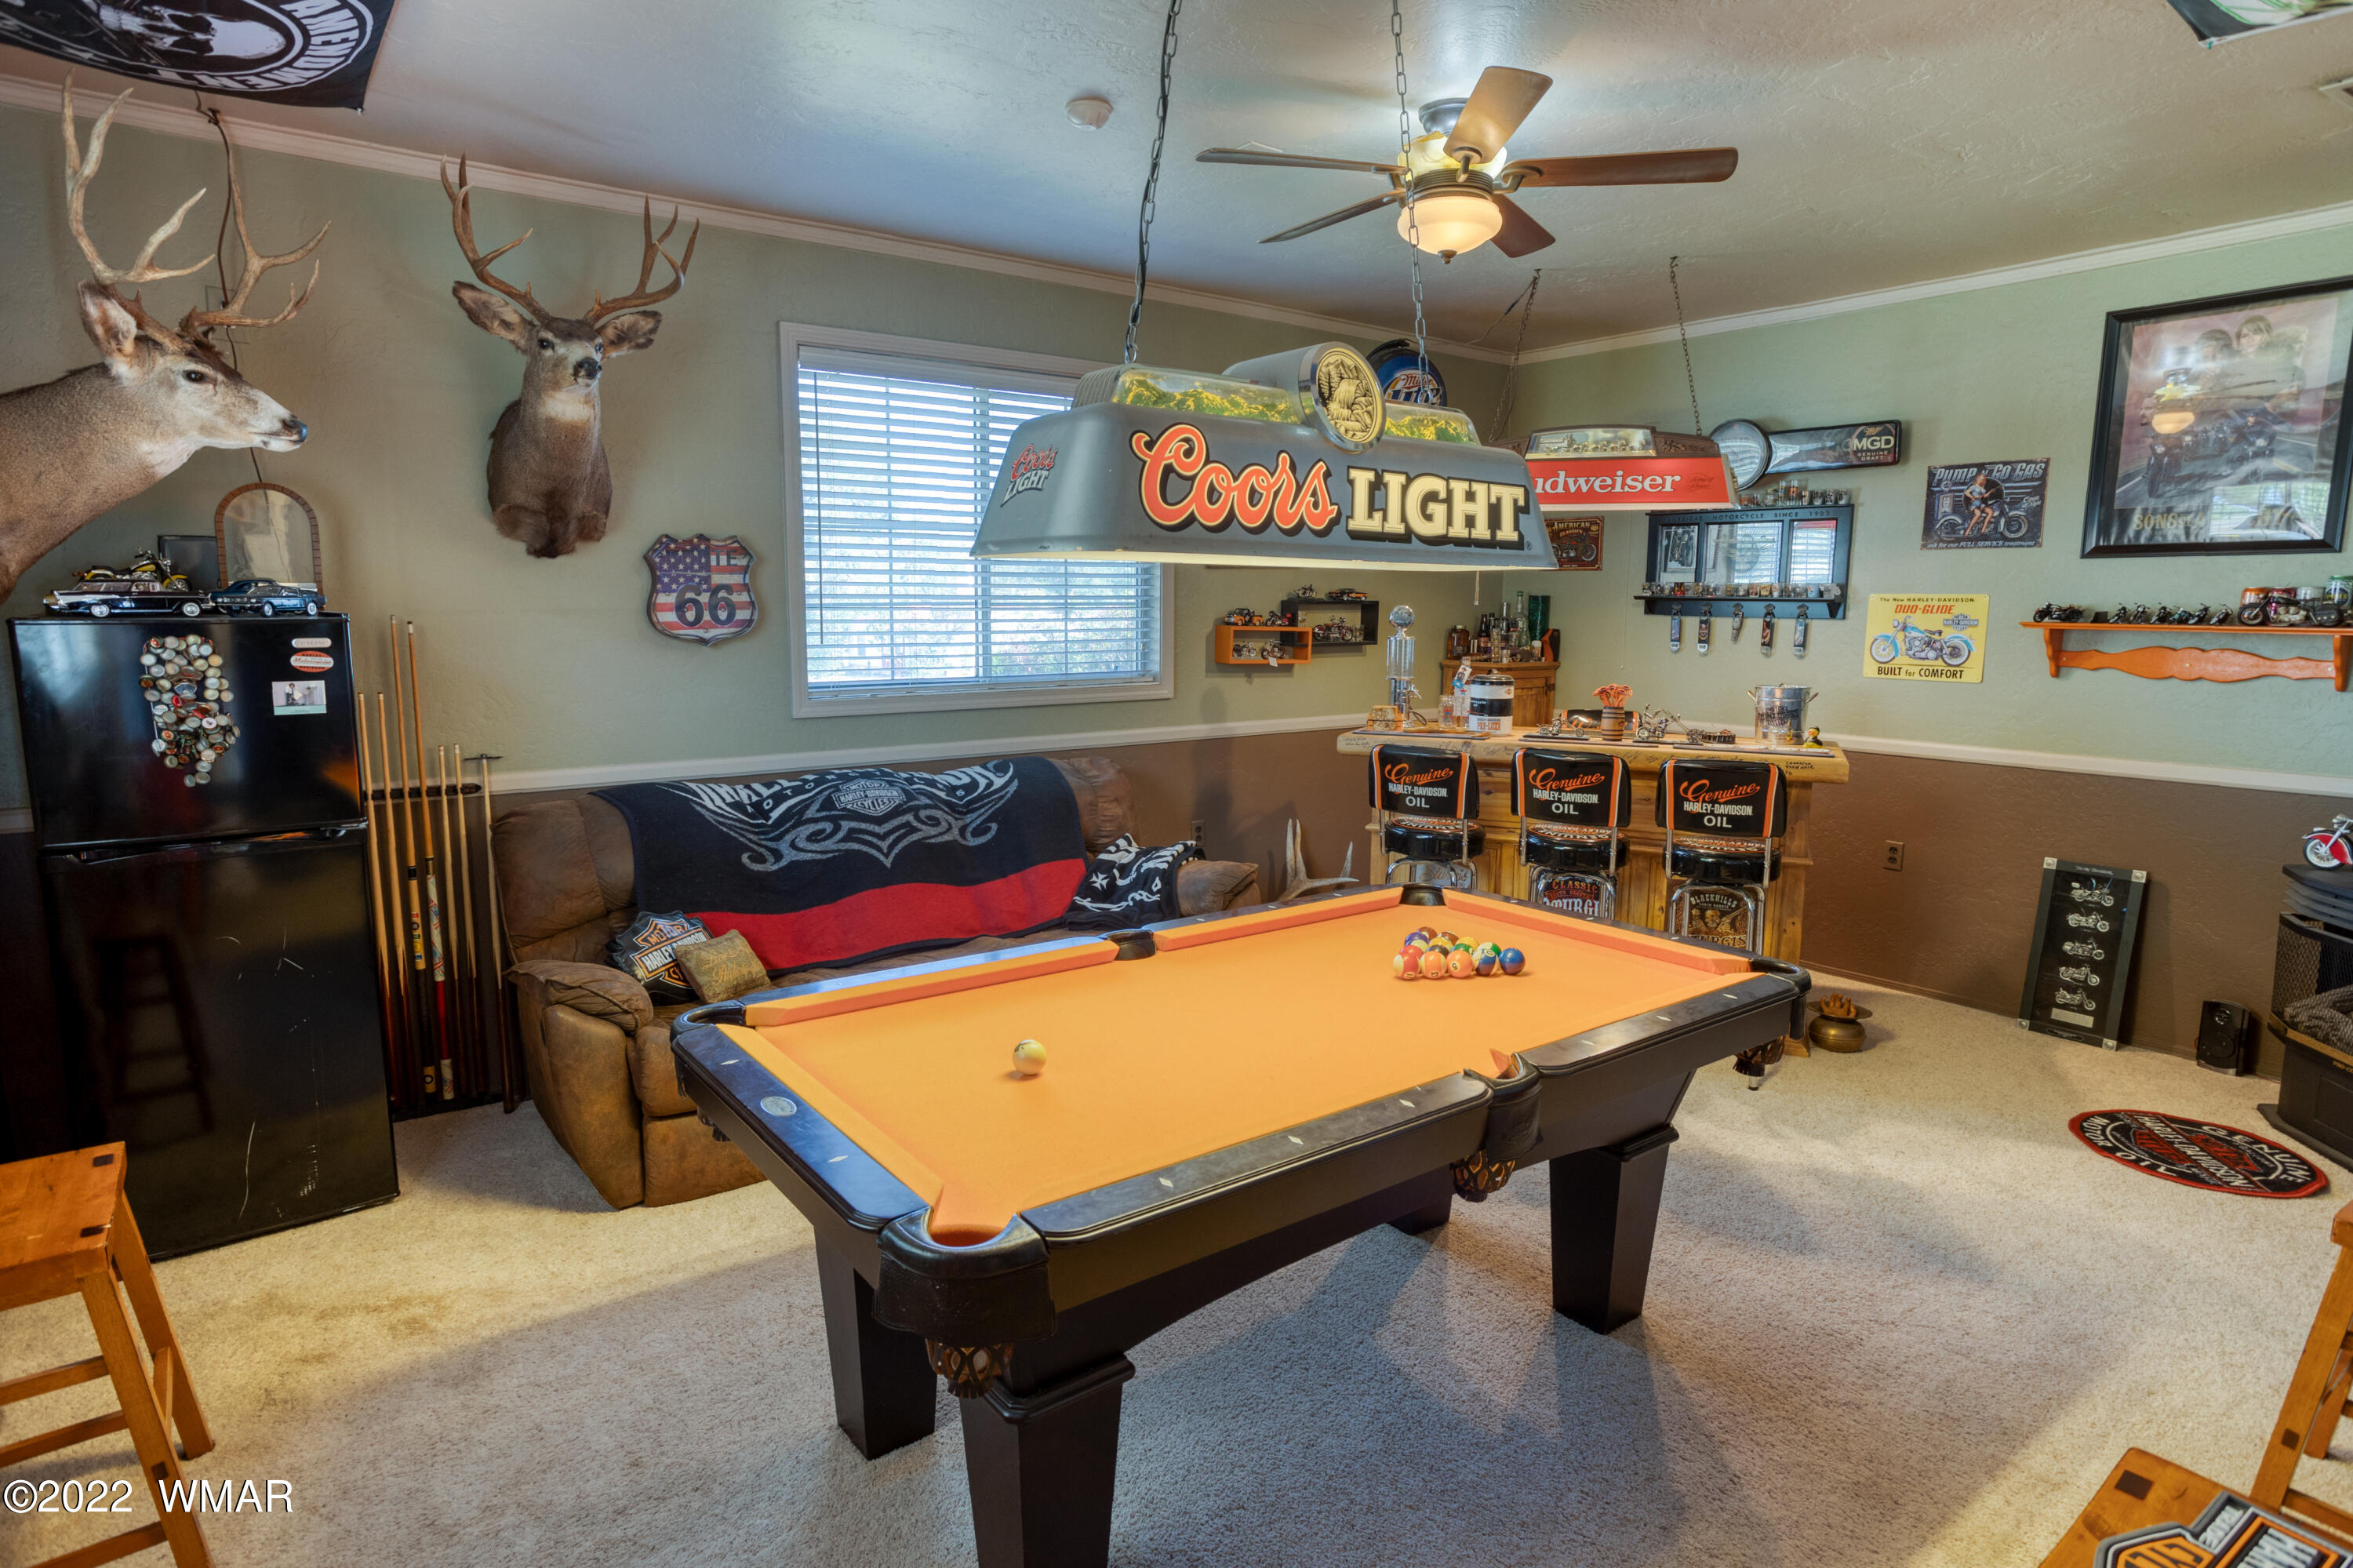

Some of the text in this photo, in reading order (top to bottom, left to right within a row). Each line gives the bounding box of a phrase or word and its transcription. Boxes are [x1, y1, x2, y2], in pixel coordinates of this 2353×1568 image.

[1853, 435, 1894, 451] MGD
[1011, 444, 1058, 481] Coors
[1535, 471, 1681, 493] udweiser
[1932, 468, 1977, 486] PUMP
[1989, 464, 2012, 480] GO
[2013, 463, 2046, 481] GAS
[1003, 470, 1049, 504] LIGHT
[1130, 423, 1527, 545] Coors LIGHT
[1553, 521, 1590, 532] AMERICAN
[2133, 513, 2178, 530] SONS
[675, 582, 736, 628] 66
[1894, 604, 1955, 614] DUO-GLIDE
[1878, 667, 1902, 676] BUILT
[1918, 668, 1964, 678] COMFORT
[1384, 763, 1453, 792] Genuine
[1529, 768, 1605, 799] Genuine
[839, 789, 899, 803] HARLEY-DAVIDSON
[1388, 783, 1448, 797] HARLEY-DAVIDSON
[1533, 788, 1599, 804] HARLEY-DAVIDSON
[1679, 779, 1761, 812] Genuine
[858, 799, 889, 811] CYCLES
[1406, 796, 1430, 808] OIL
[1551, 802, 1579, 815] OIL
[1684, 801, 1753, 816] HARLEY-DAVIDSON
[1704, 815, 1732, 828] OIL
[1552, 879, 1598, 893] CLASSIC
[647, 923, 684, 944] MOTOR
[2082, 1115, 2111, 1148] MOTOR
[2115, 1151, 2178, 1177] OIL
[2133, 1115, 2257, 1188] HARLEY-DAVIDSON
[2202, 1125, 2312, 1183] GENUINE
